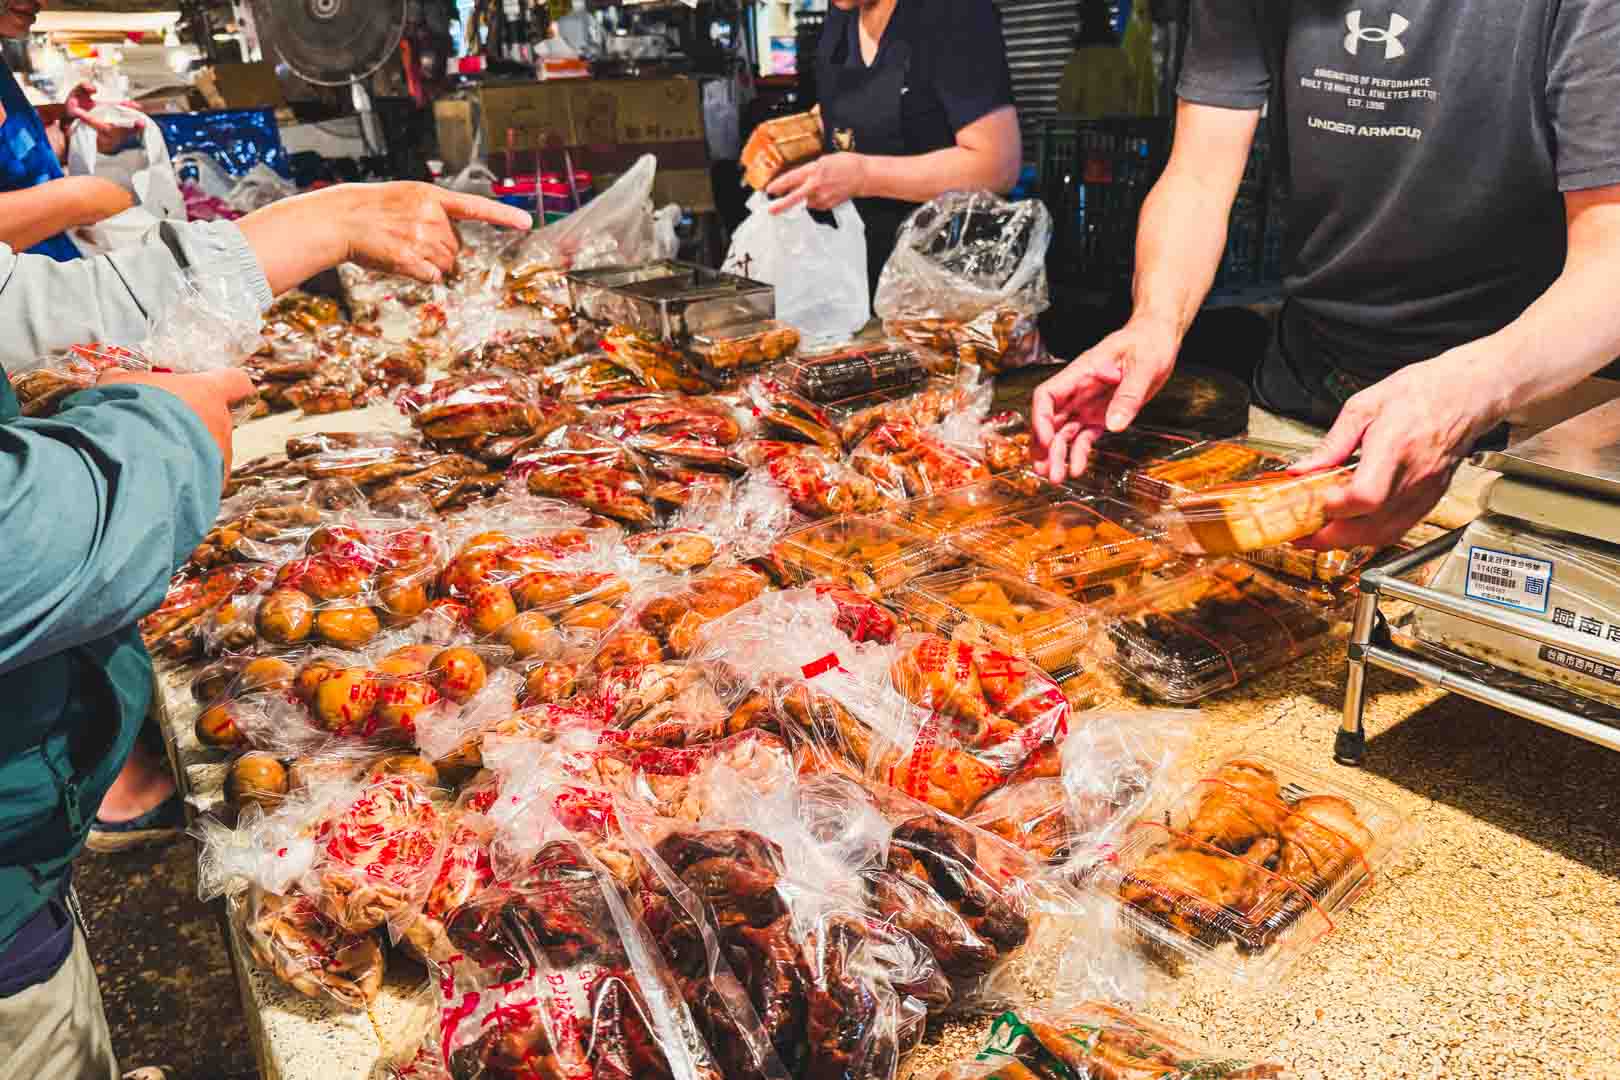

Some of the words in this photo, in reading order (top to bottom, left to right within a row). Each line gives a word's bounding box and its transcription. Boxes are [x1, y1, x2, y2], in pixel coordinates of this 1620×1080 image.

[1301, 78, 1322, 90] BUILT
[1323, 80, 1333, 91] TO
[1353, 86, 1367, 97] ALL
[1368, 87, 1409, 99] ATHLETES
[1360, 75, 1370, 86] OF
[1371, 77, 1432, 88] PERFORMANCE
[1346, 98, 1364, 109] EST.
[1307, 116, 1355, 136] UNDER
[1357, 124, 1422, 140] ARMOUR
